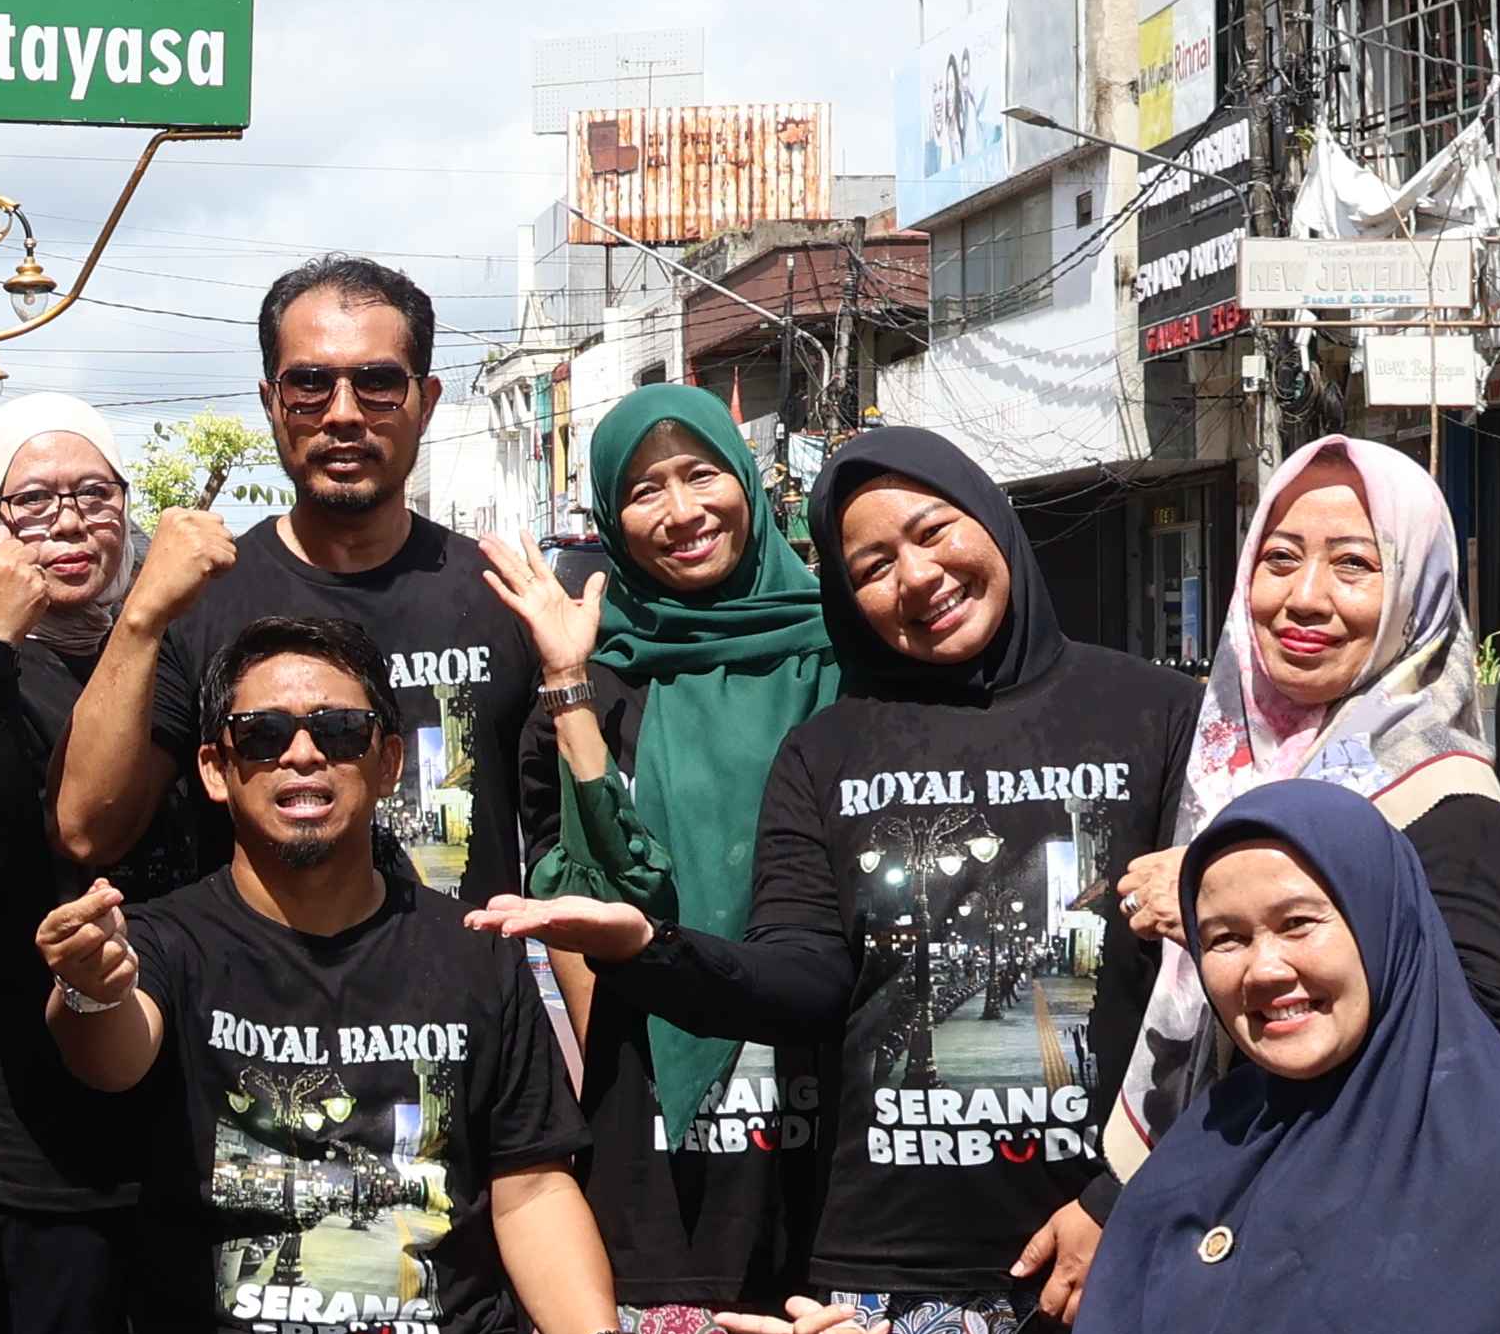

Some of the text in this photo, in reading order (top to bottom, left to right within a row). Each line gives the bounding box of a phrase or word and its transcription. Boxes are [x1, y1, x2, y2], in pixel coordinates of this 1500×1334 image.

[1173, 25, 1212, 82] Rinnai
[1249, 260, 1309, 292] NEW
[840, 762, 1131, 818] ROYAL BAROE
[208, 1008, 470, 1066] ROYAL BAROE
[873, 1084, 1089, 1126] SERANG
[232, 1281, 434, 1324] SERANG
